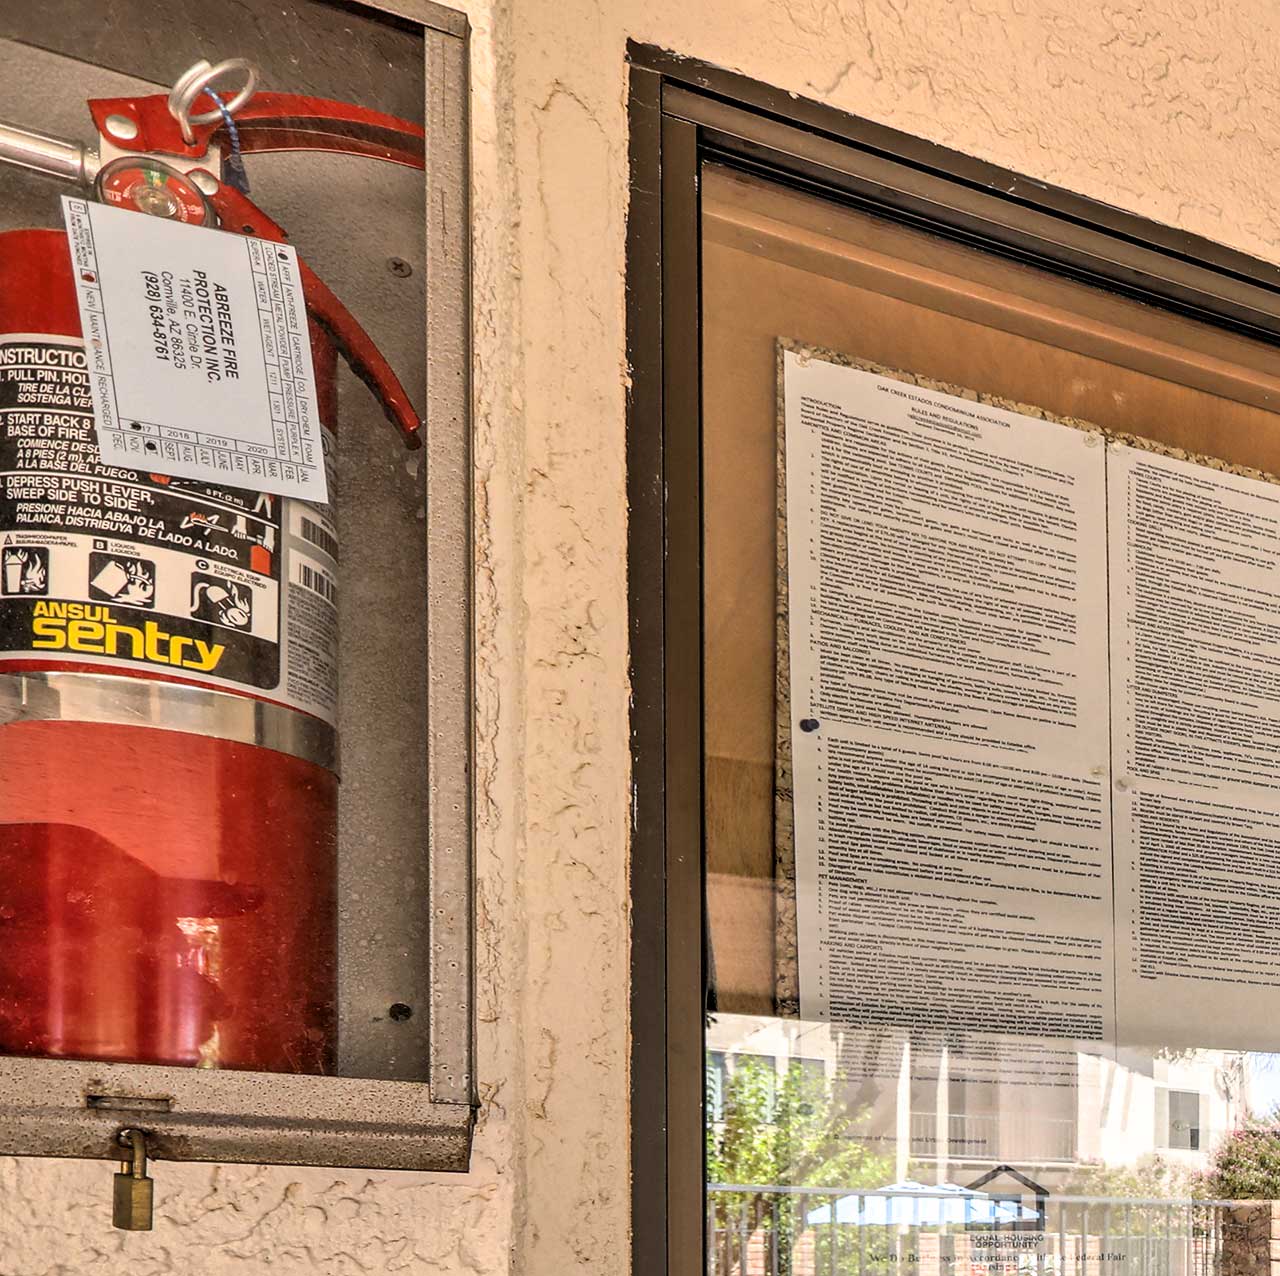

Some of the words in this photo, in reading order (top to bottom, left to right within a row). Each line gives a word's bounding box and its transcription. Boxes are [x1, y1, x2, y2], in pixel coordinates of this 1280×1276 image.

[141, 270, 162, 302] (928)
[180, 279, 194, 308] 11400
[168, 318, 182, 336] AZ
[184, 310, 196, 320] E.
[192, 269, 218, 356] PROTECTION
[205, 358, 221, 384] INC.
[213, 282, 235, 347] ABREEZE
[149, 305, 170, 361] 634-8761
[186, 323, 200, 353] Circle
[170, 336, 186, 370] 86325
[191, 356, 202, 369] Dr.
[222, 348, 239, 380] FIRE
[8, 370, 34, 381] PULL
[37, 370, 60, 382] PIN.
[98, 376, 112, 426] RECHARGED
[8, 414, 41, 425] START
[44, 416, 79, 428] BACK
[82, 419, 90, 429] 8
[8, 426, 36, 437] BASE
[38, 426, 55, 437] OF
[58, 428, 91, 441] FIRE.
[167, 429, 190, 440] 2018
[206, 437, 228, 447] 2019
[247, 445, 268, 455] 2020
[6, 476, 59, 489] DEPRESS
[62, 478, 100, 493] PUSH
[104, 484, 154, 505] LEVER,
[6, 488, 45, 500] SWEEP
[47, 489, 78, 502] SIDE
[82, 492, 101, 505] TO
[104, 495, 141, 512] SIDE.
[16, 503, 66, 514] PRESIONE
[67, 506, 102, 518] HACIA
[104, 512, 146, 528] ABAJO
[148, 518, 165, 530] LA
[32, 600, 117, 624] ANSUL
[32, 618, 226, 672] sentry
